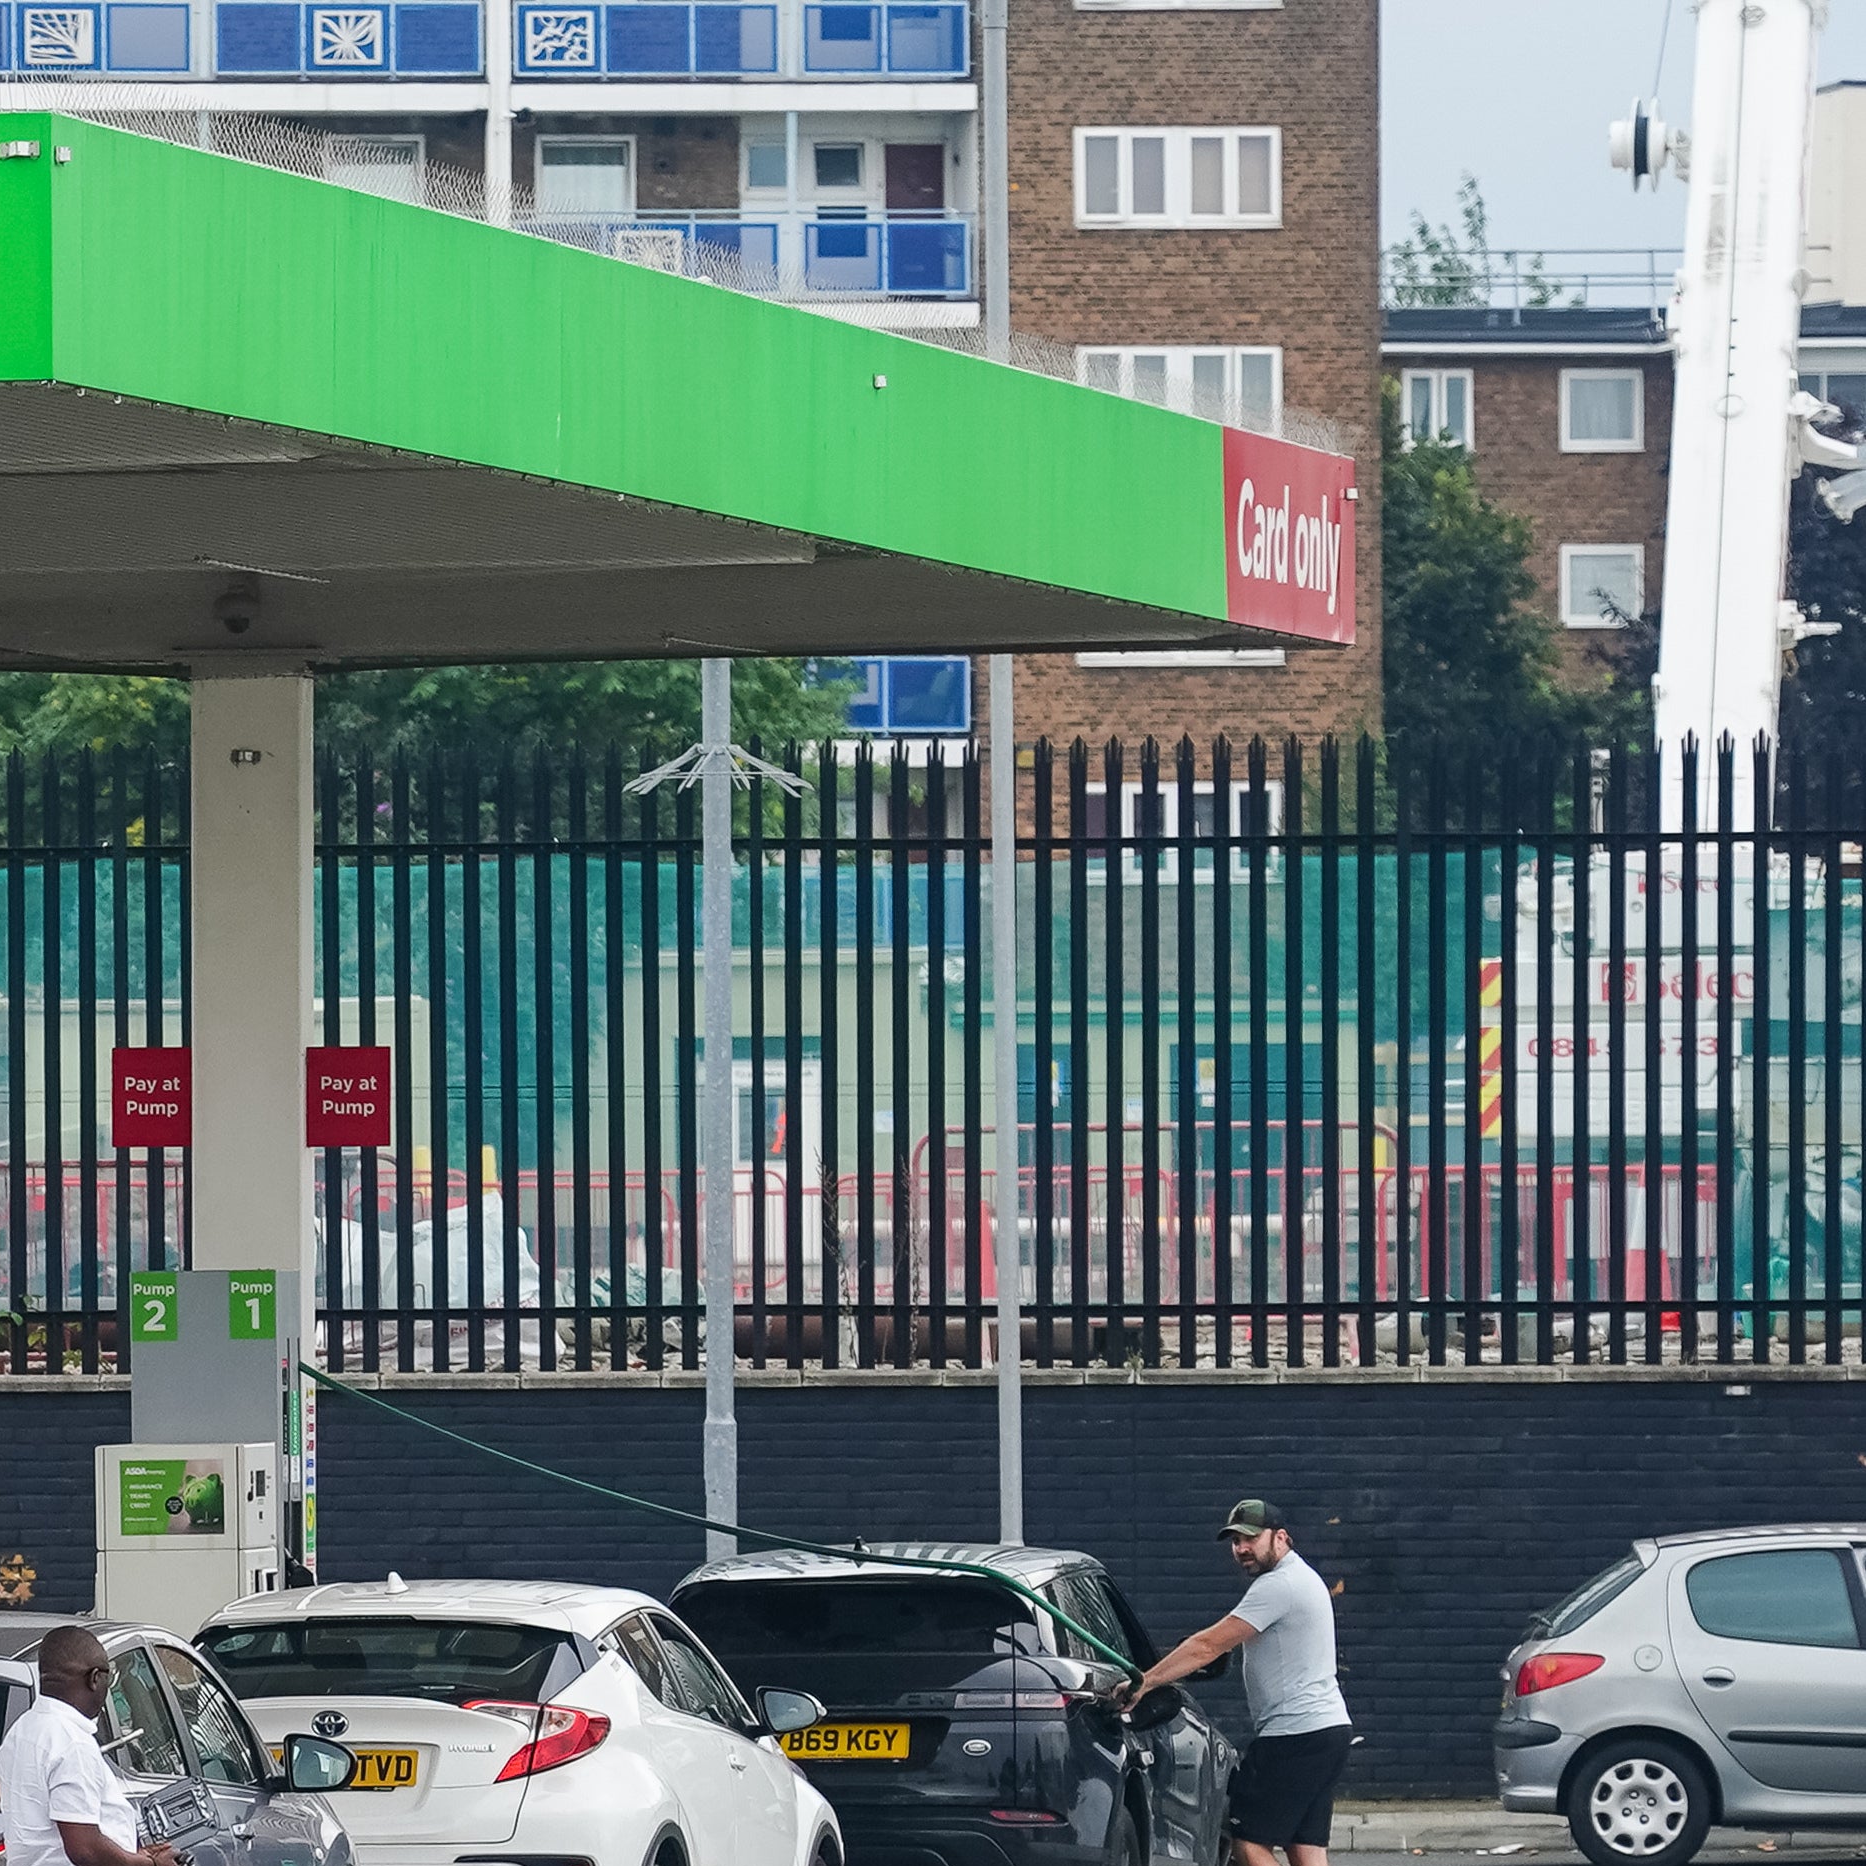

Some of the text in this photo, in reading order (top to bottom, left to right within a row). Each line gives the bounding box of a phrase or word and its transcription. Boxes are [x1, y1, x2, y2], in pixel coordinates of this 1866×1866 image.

[1237, 478, 1341, 615] Card only
[124, 1076, 181, 1094] Pay at
[320, 1076, 377, 1093] Pay at
[126, 1101, 179, 1118] Pump
[322, 1100, 375, 1116] Pump
[133, 1283, 175, 1297] Pump
[231, 1282, 273, 1295] Pump
[143, 1300, 166, 1332] 2
[245, 1298, 260, 1330] 1
[449, 1744, 488, 1753] HYBRID
[846, 1729, 899, 1751] KGY
[356, 1755, 413, 1782] TVD
